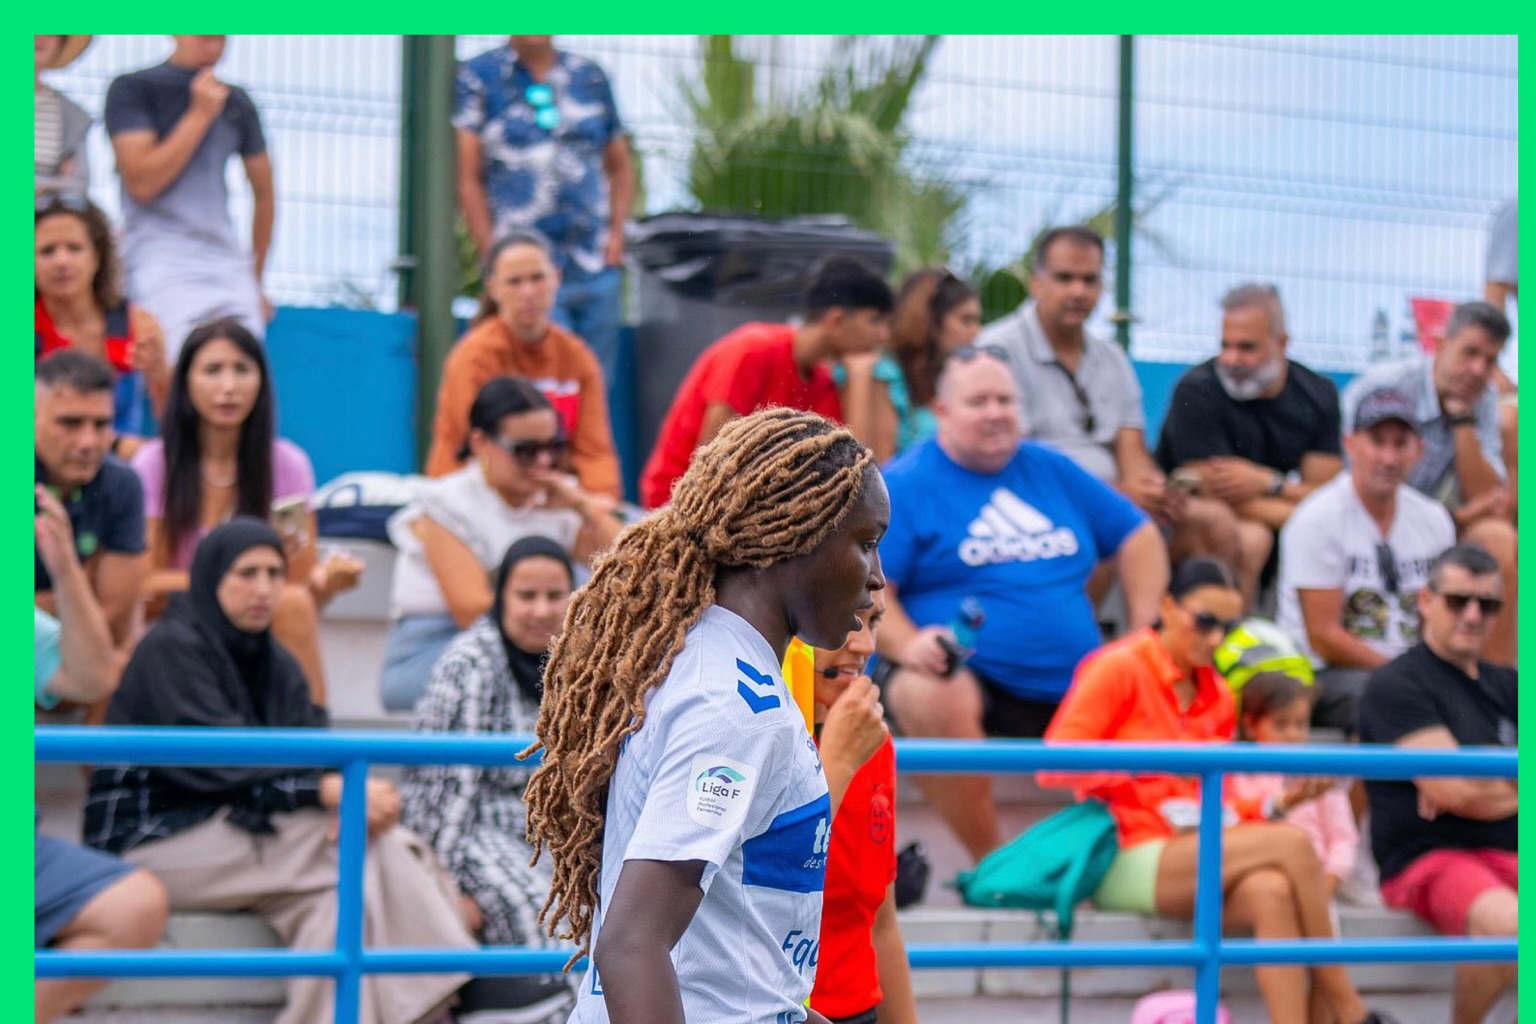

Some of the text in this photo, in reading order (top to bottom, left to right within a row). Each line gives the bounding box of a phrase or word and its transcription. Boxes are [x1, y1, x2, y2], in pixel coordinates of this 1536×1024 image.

[957, 526, 1079, 567] adidas
[702, 782, 741, 799] Liga F
